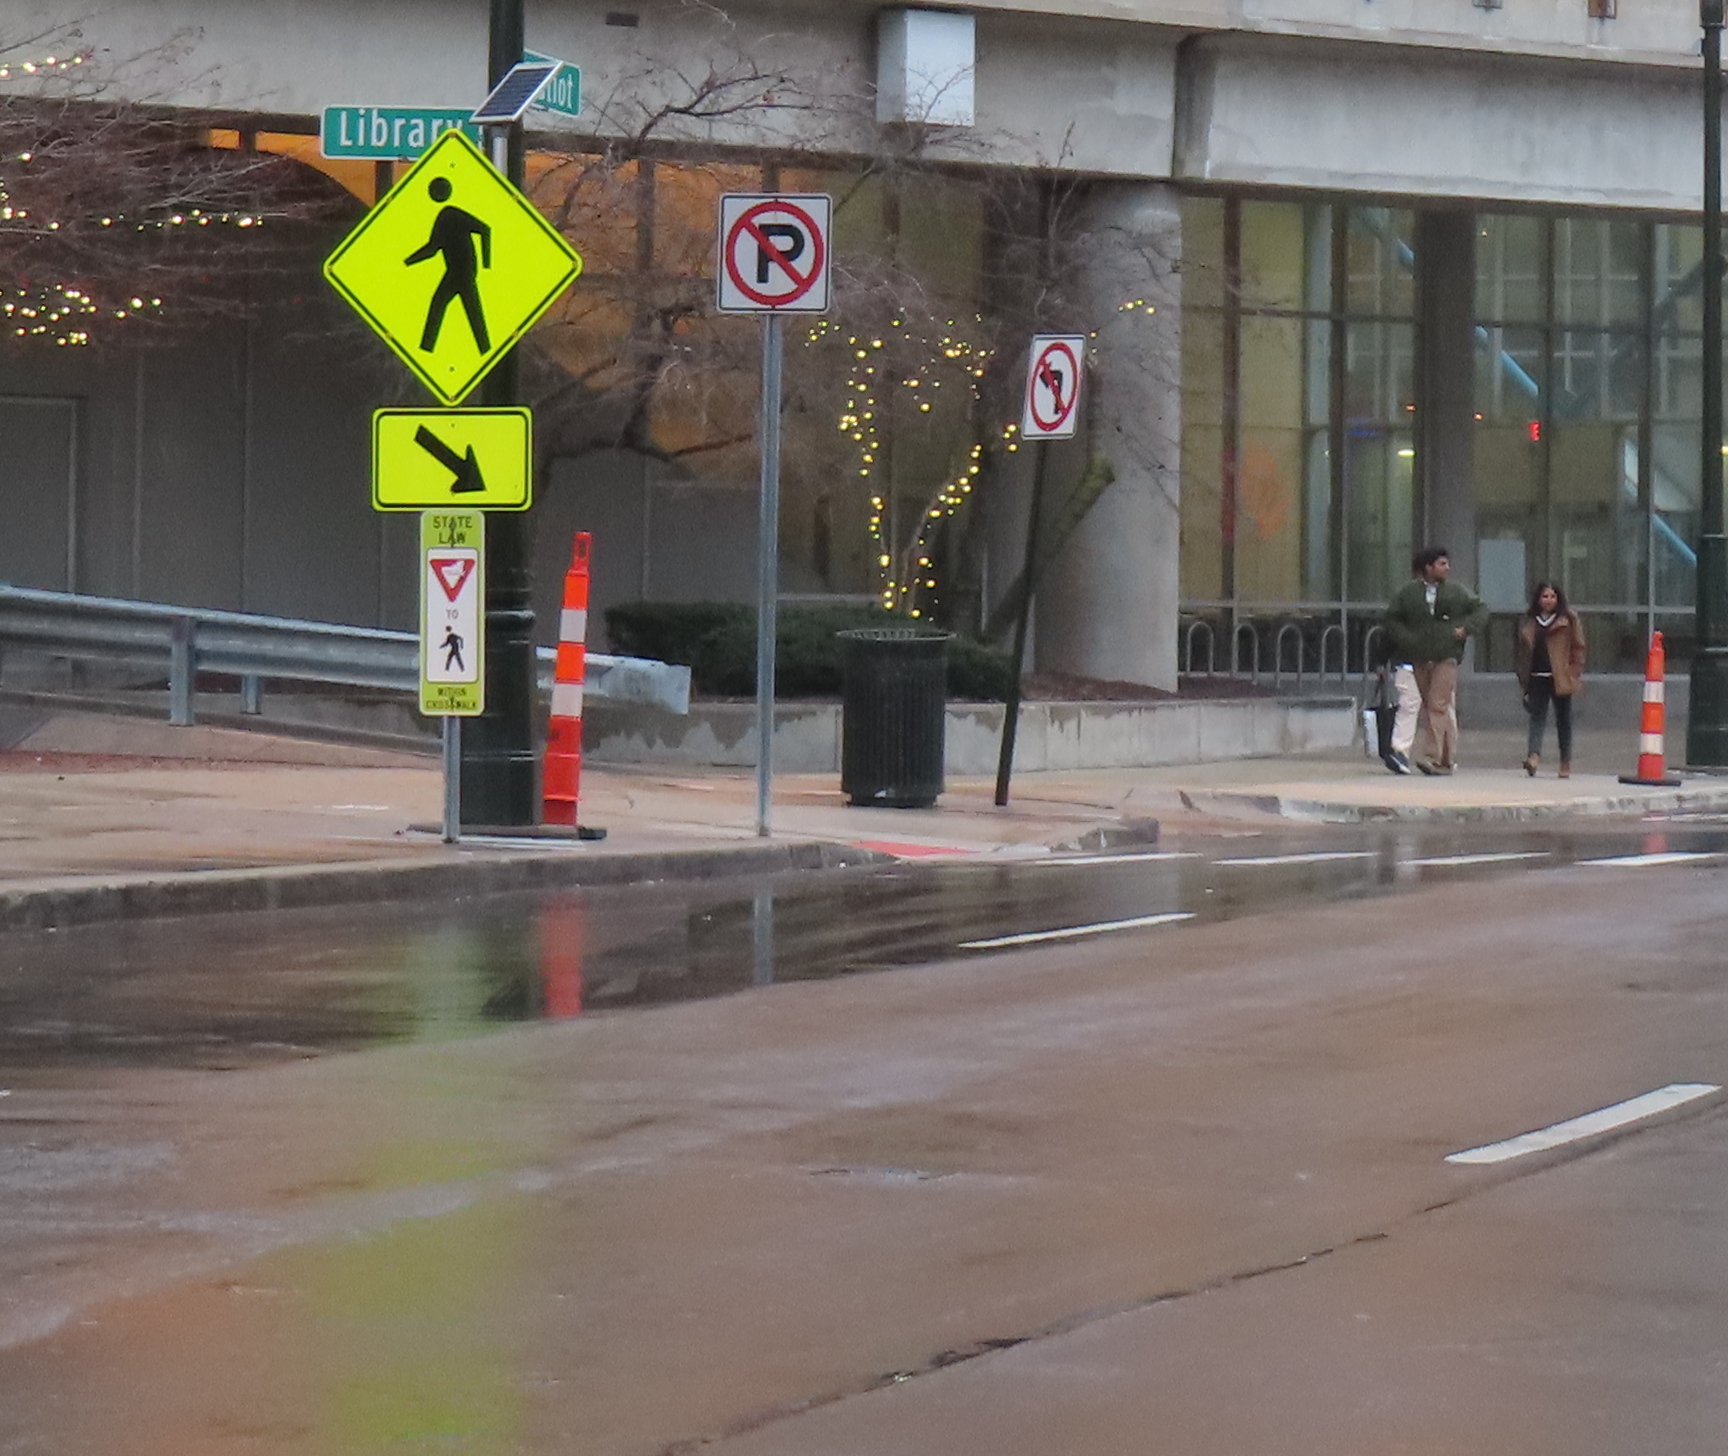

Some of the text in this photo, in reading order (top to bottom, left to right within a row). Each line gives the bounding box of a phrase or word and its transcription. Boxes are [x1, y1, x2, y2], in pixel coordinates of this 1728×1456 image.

[432, 515, 473, 529] STATE
[438, 532, 466, 545] LAW
[446, 608, 459, 619] TO
